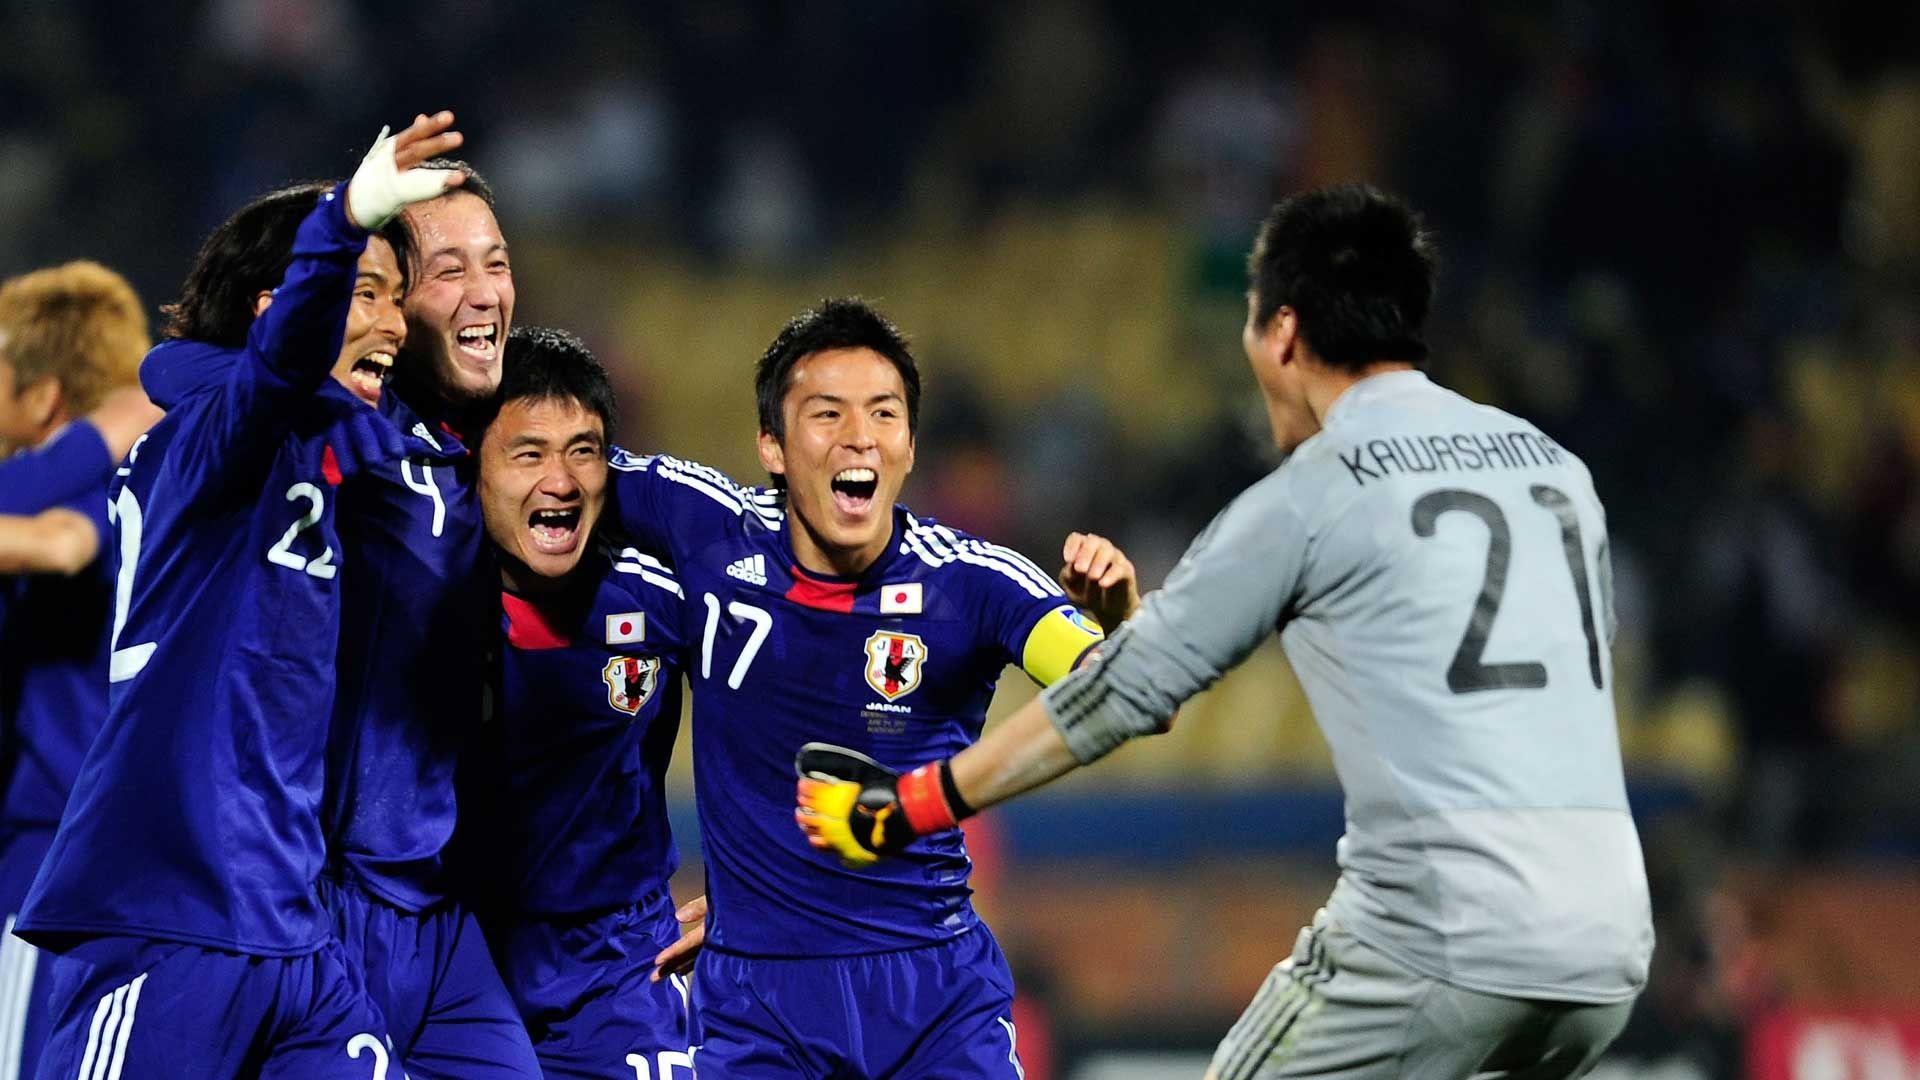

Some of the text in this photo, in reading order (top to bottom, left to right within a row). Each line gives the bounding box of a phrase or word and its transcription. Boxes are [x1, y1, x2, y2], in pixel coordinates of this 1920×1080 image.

[401, 458, 446, 537] 4
[726, 564, 768, 586] adidas
[1410, 483, 1603, 694] 21
[702, 592, 773, 690] 17
[865, 702, 911, 713] JAPAN
